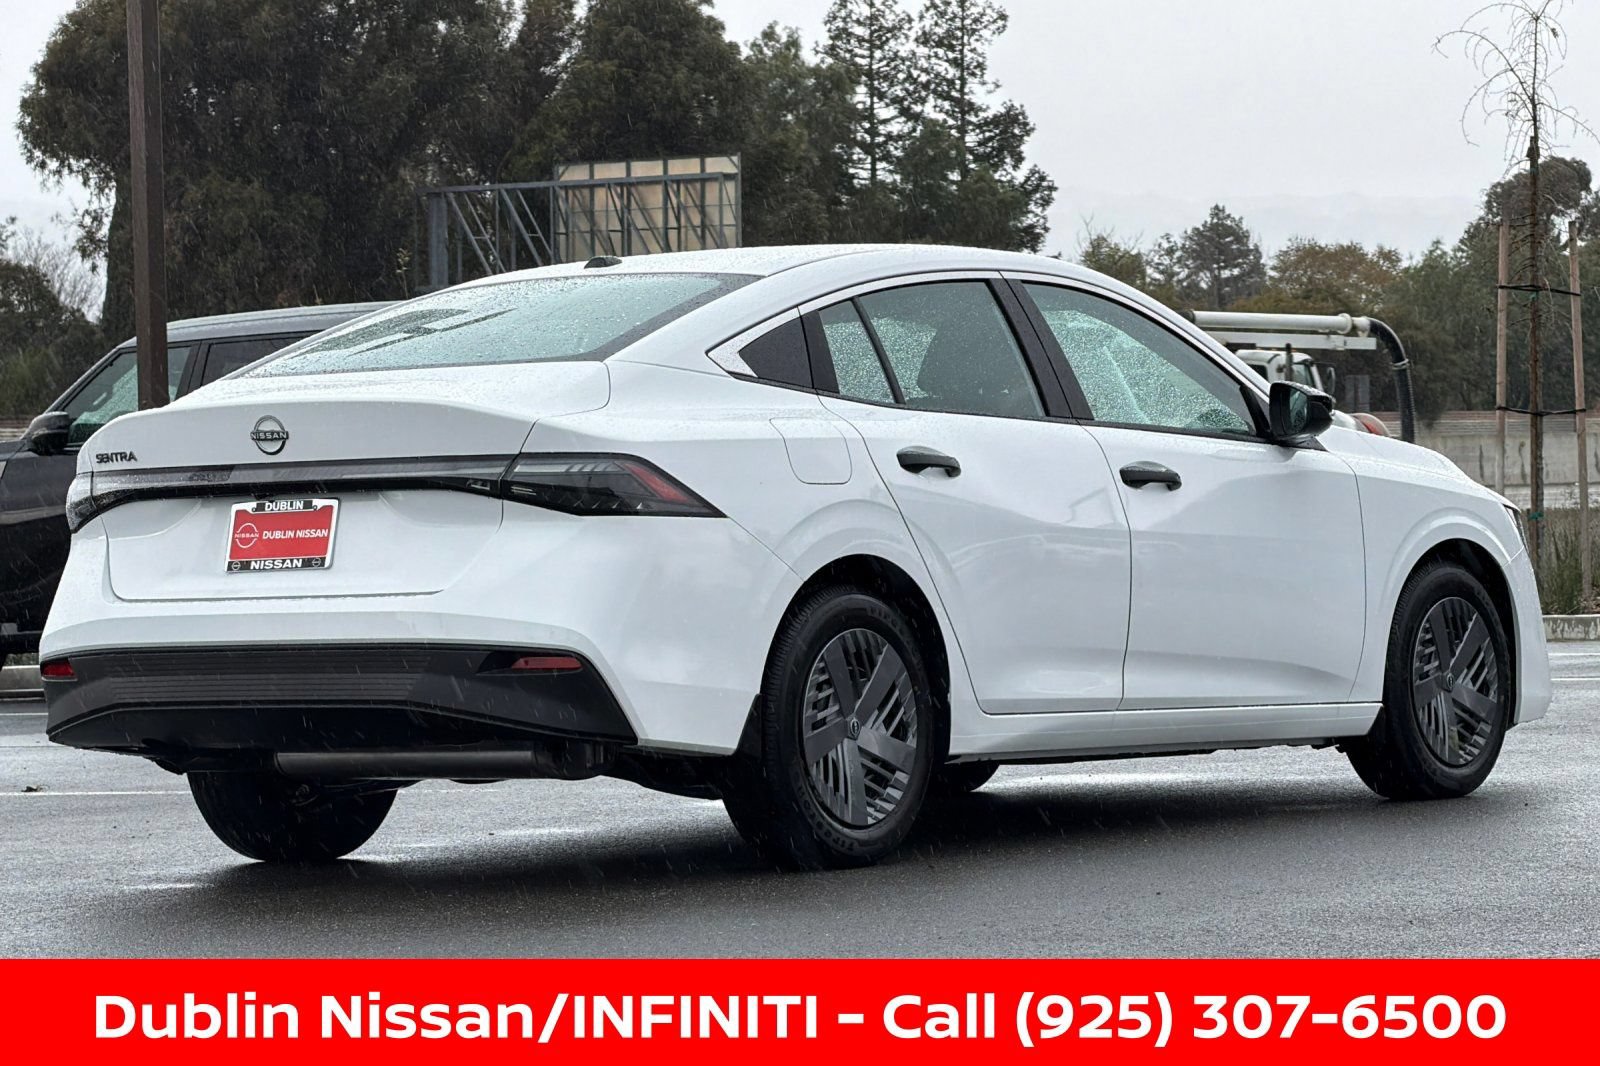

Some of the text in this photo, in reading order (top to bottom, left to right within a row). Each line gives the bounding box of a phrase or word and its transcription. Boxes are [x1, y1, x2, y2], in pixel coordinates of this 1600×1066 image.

[250, 431, 287, 440] NISSAN
[96, 451, 137, 463] SENTRA
[265, 500, 304, 511] DUBLIN
[262, 528, 329, 539] DUBLIN NISSAN
[250, 558, 303, 570] NISSAN
